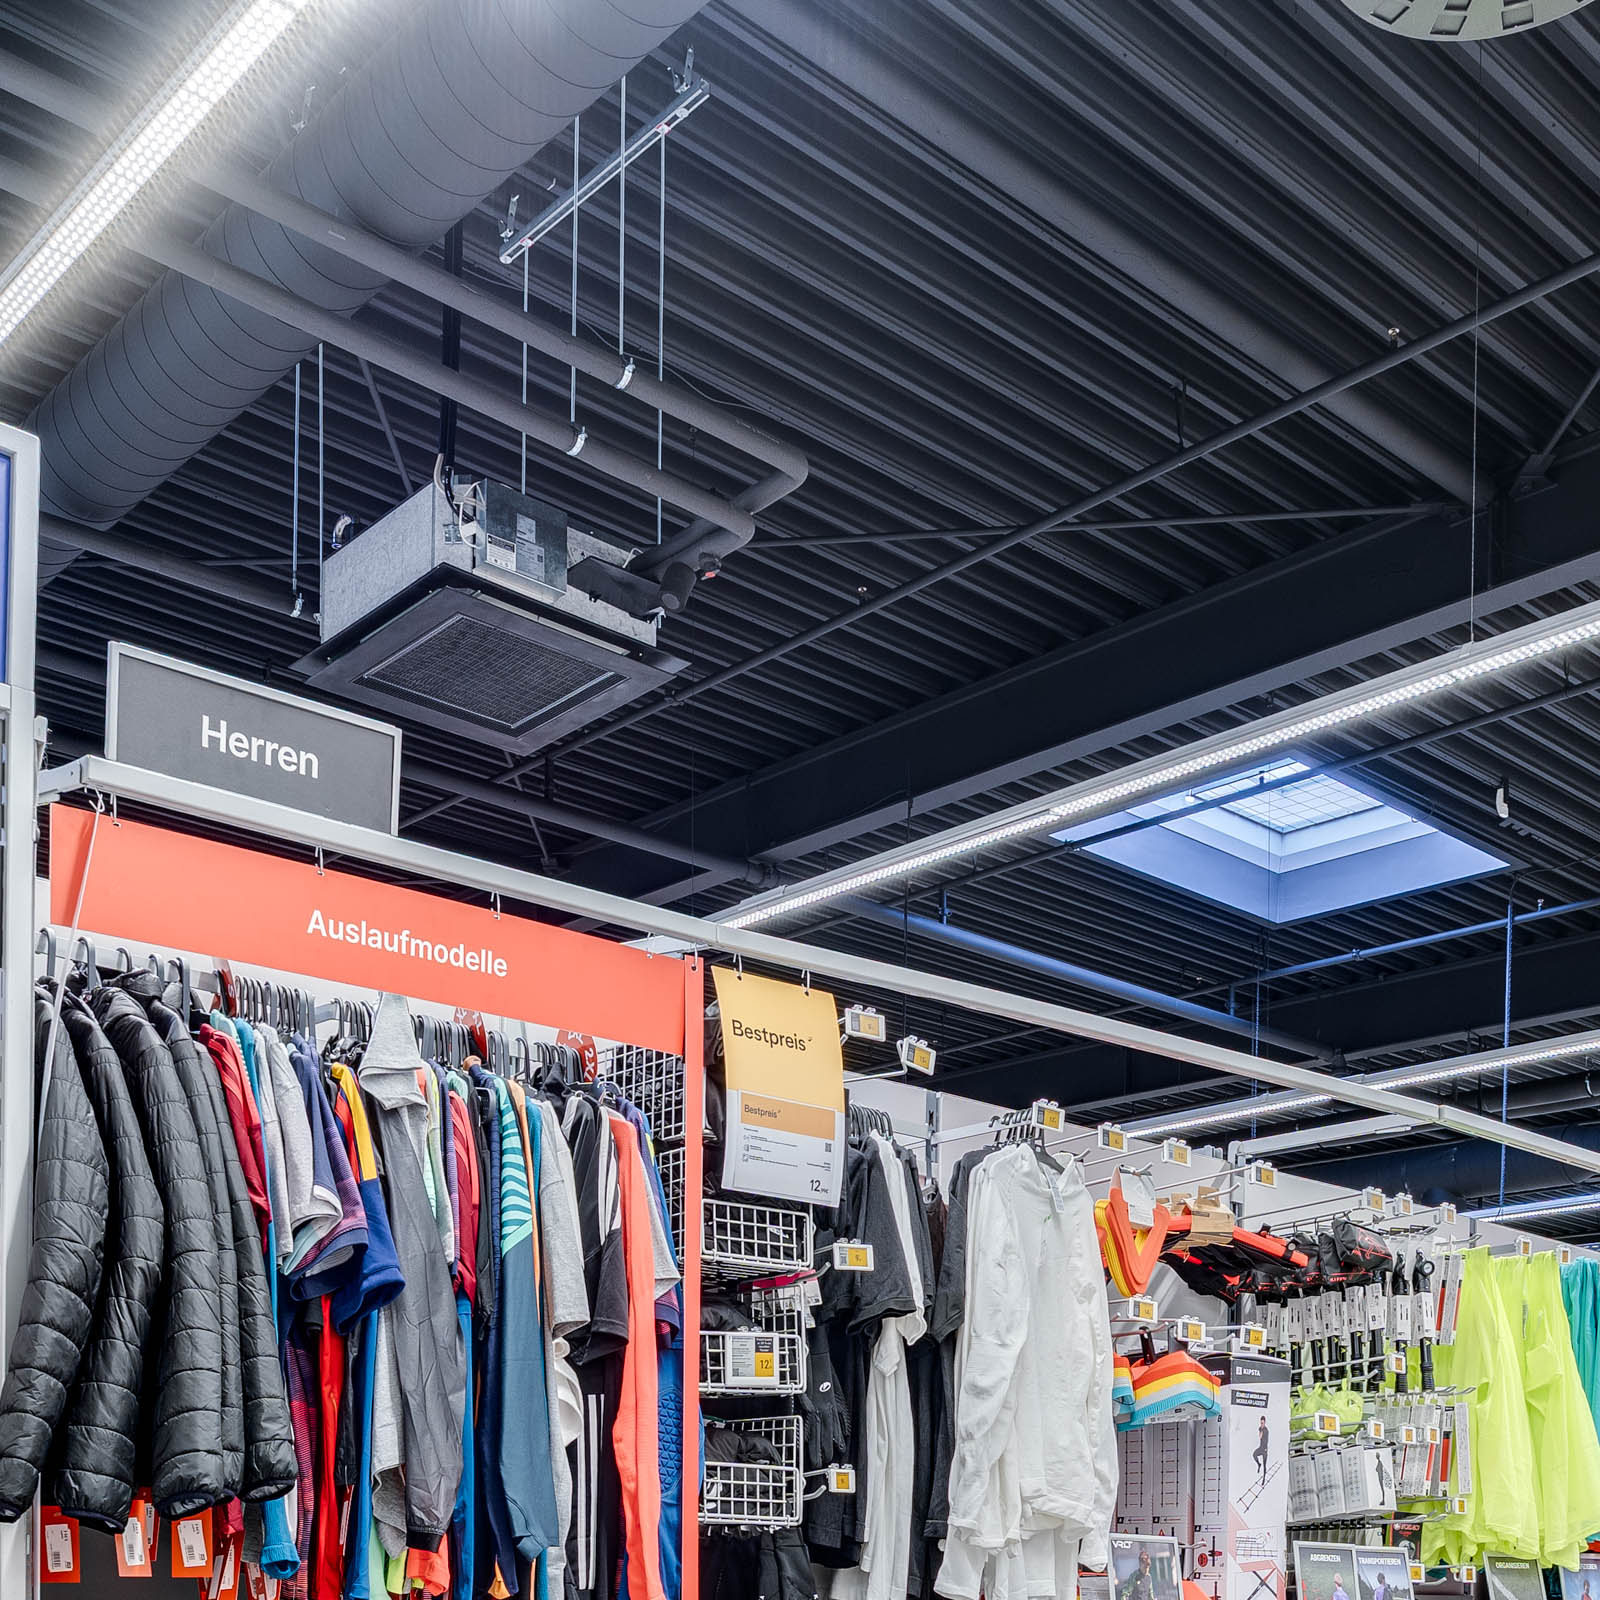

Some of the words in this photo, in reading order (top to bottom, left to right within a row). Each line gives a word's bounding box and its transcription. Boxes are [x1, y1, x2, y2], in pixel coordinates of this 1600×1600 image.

[200, 714, 320, 781] Herren
[307, 909, 508, 978] Auslaufmodelle
[732, 1019, 806, 1051] Bestpreis
[744, 1104, 777, 1119] Bestpreis
[1243, 1368, 1260, 1376] KIPSTA
[1310, 1553, 1341, 1563] ABGRENZEN
[1358, 1557, 1402, 1567] TRANSPORTIEREN
